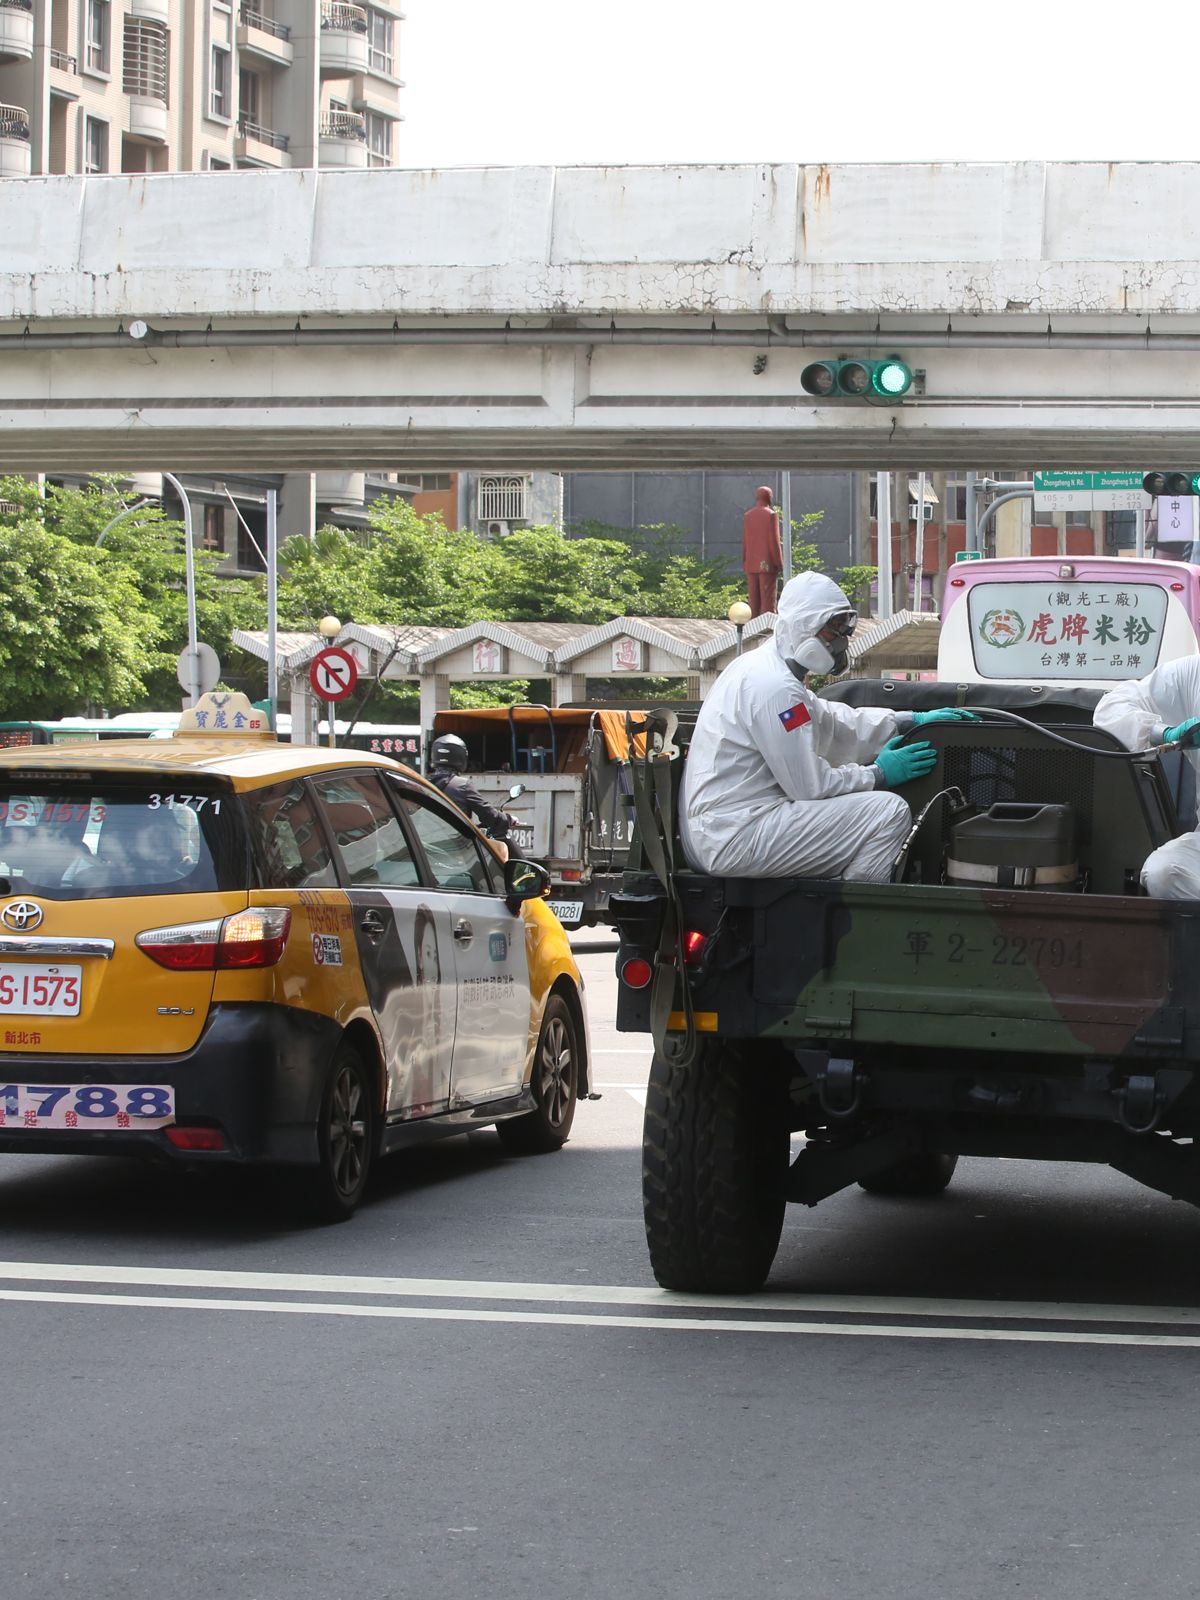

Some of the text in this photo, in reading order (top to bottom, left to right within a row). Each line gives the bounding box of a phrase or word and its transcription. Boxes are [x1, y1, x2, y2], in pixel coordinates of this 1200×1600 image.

[1170, 494, 1181, 529] 中心
[1047, 592, 1139, 608] (觀光工廠)
[1026, 612, 1157, 646] 虎牌米粉
[1040, 652, 1142, 669] 台灣第一品牌
[147, 794, 221, 815] 31771
[5, 1031, 41, 1045] 新北市
